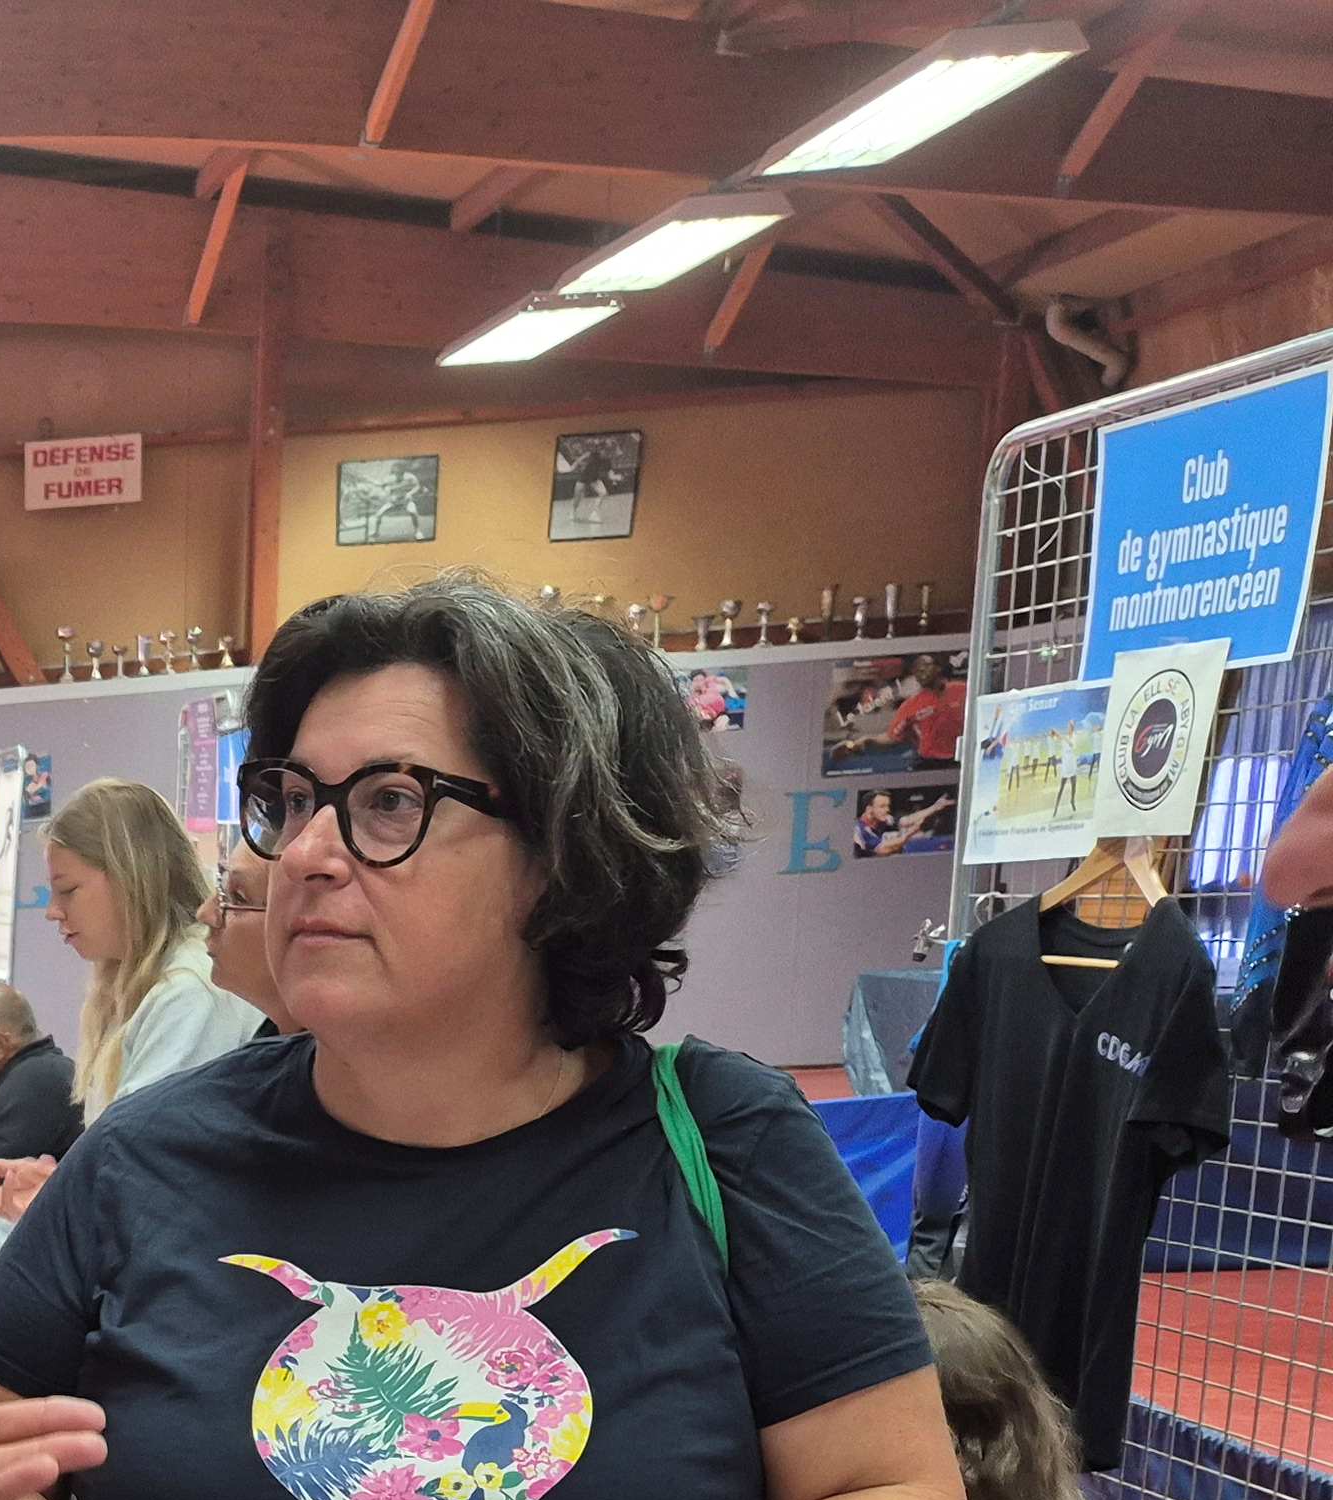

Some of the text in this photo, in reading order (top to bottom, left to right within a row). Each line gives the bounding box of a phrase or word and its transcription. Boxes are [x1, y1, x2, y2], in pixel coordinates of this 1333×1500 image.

[33, 443, 135, 467] DEFENSE
[1182, 449, 1230, 504] Club
[44, 478, 123, 500] FUMER
[1118, 503, 1288, 582] de gymnastique
[1109, 561, 1281, 632] montmorencéen
